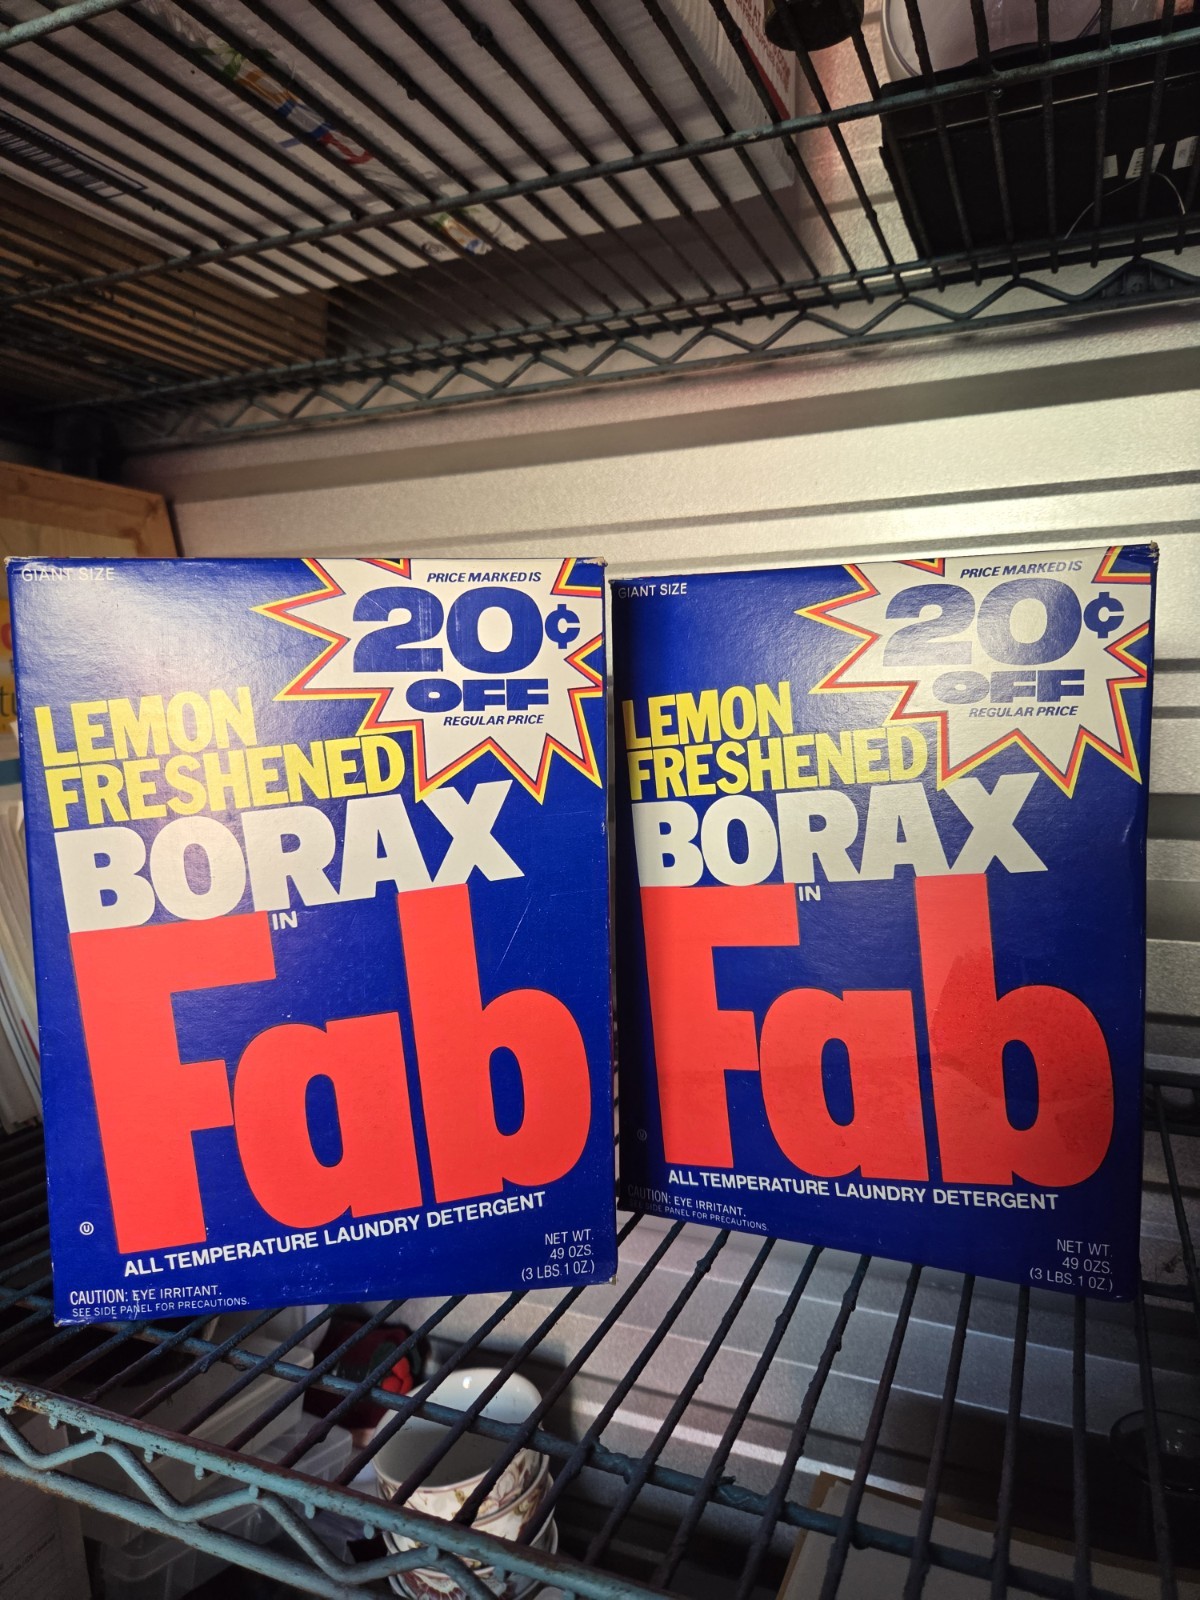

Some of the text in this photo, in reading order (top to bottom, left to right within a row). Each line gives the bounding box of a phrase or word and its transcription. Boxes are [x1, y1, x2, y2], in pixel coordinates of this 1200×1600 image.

[21, 566, 115, 582] GIANT SIZE
[426, 571, 542, 583] PRICE MARKED IS
[959, 560, 1083, 579] PRICE MARKED IS
[617, 582, 688, 599] GIANT SIZE
[405, 678, 549, 713] OFF
[932, 669, 1085, 704] OFF
[442, 714, 545, 727] REGULAR PRICE
[622, 681, 793, 752] LEMON
[968, 705, 1079, 719] REGULAR PRICE
[34, 686, 257, 768] LEMON
[626, 726, 928, 800] FRESHENED
[44, 734, 406, 829] FRESHENED
[632, 772, 1048, 888] BORAX
[53, 779, 525, 934] BORAX
[798, 885, 821, 903] IN
[271, 911, 298, 931] IN
[640, 873, 1115, 1188] Fab
[69, 883, 592, 1255] Fab
[628, 1184, 747, 1218] CAUTION: EYE IRRITANT.
[668, 1169, 1058, 1212] ALL TEMPERATURE LAUNDRY DETERGENT
[644, 1203, 663, 1213] SIDE
[664, 1205, 689, 1218] PANEL
[692, 1210, 708, 1220] FOR
[124, 1191, 546, 1278] ALL TEMPERATURE LAUNDRY DETERGENT
[544, 1228, 595, 1246] NET WT.
[549, 1244, 595, 1260] 49 OZS.
[1056, 1238, 1113, 1258] NET WT.
[521, 1267, 534, 1282] (3
[564, 1262, 569, 1276] 1
[573, 1259, 595, 1274] OZ.)
[1061, 1256, 1113, 1275] 49 OZS.
[1029, 1267, 1113, 1293] (3 LBS. 1 OZ.)
[70, 1284, 222, 1306] CAUTION: EYE IRRITANT.
[72, 1296, 250, 1318] SEE SIDE PANEL FOR PRECAUTIONS.
